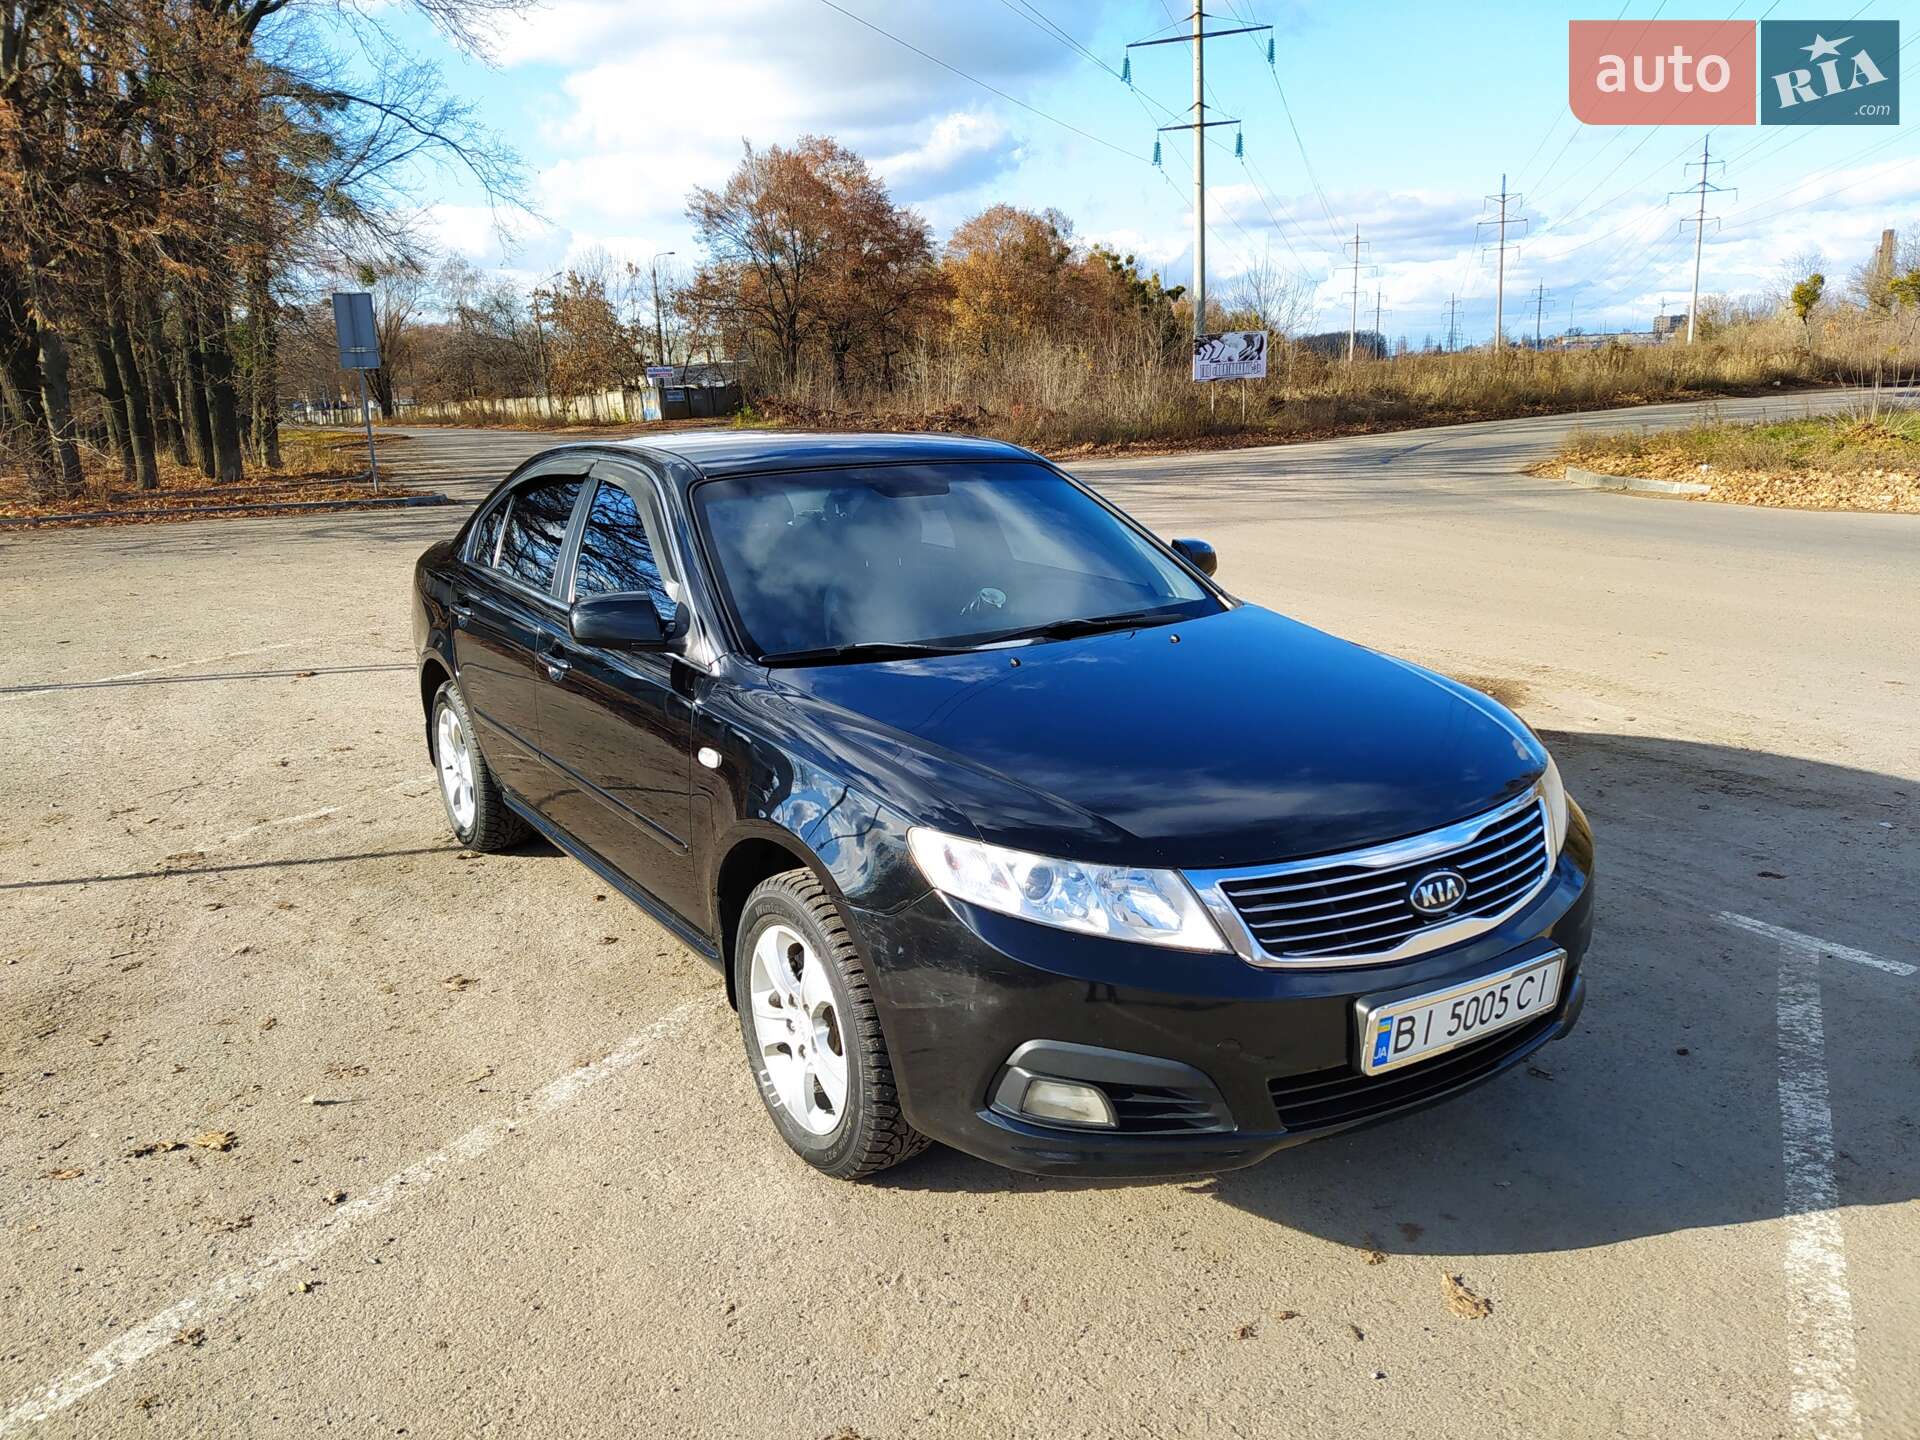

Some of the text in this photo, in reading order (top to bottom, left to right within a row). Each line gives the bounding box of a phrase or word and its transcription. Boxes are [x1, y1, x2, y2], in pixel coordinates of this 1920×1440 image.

[1420, 878, 1460, 907] KIA
[1393, 969, 1548, 1055] BI 5005 CI
